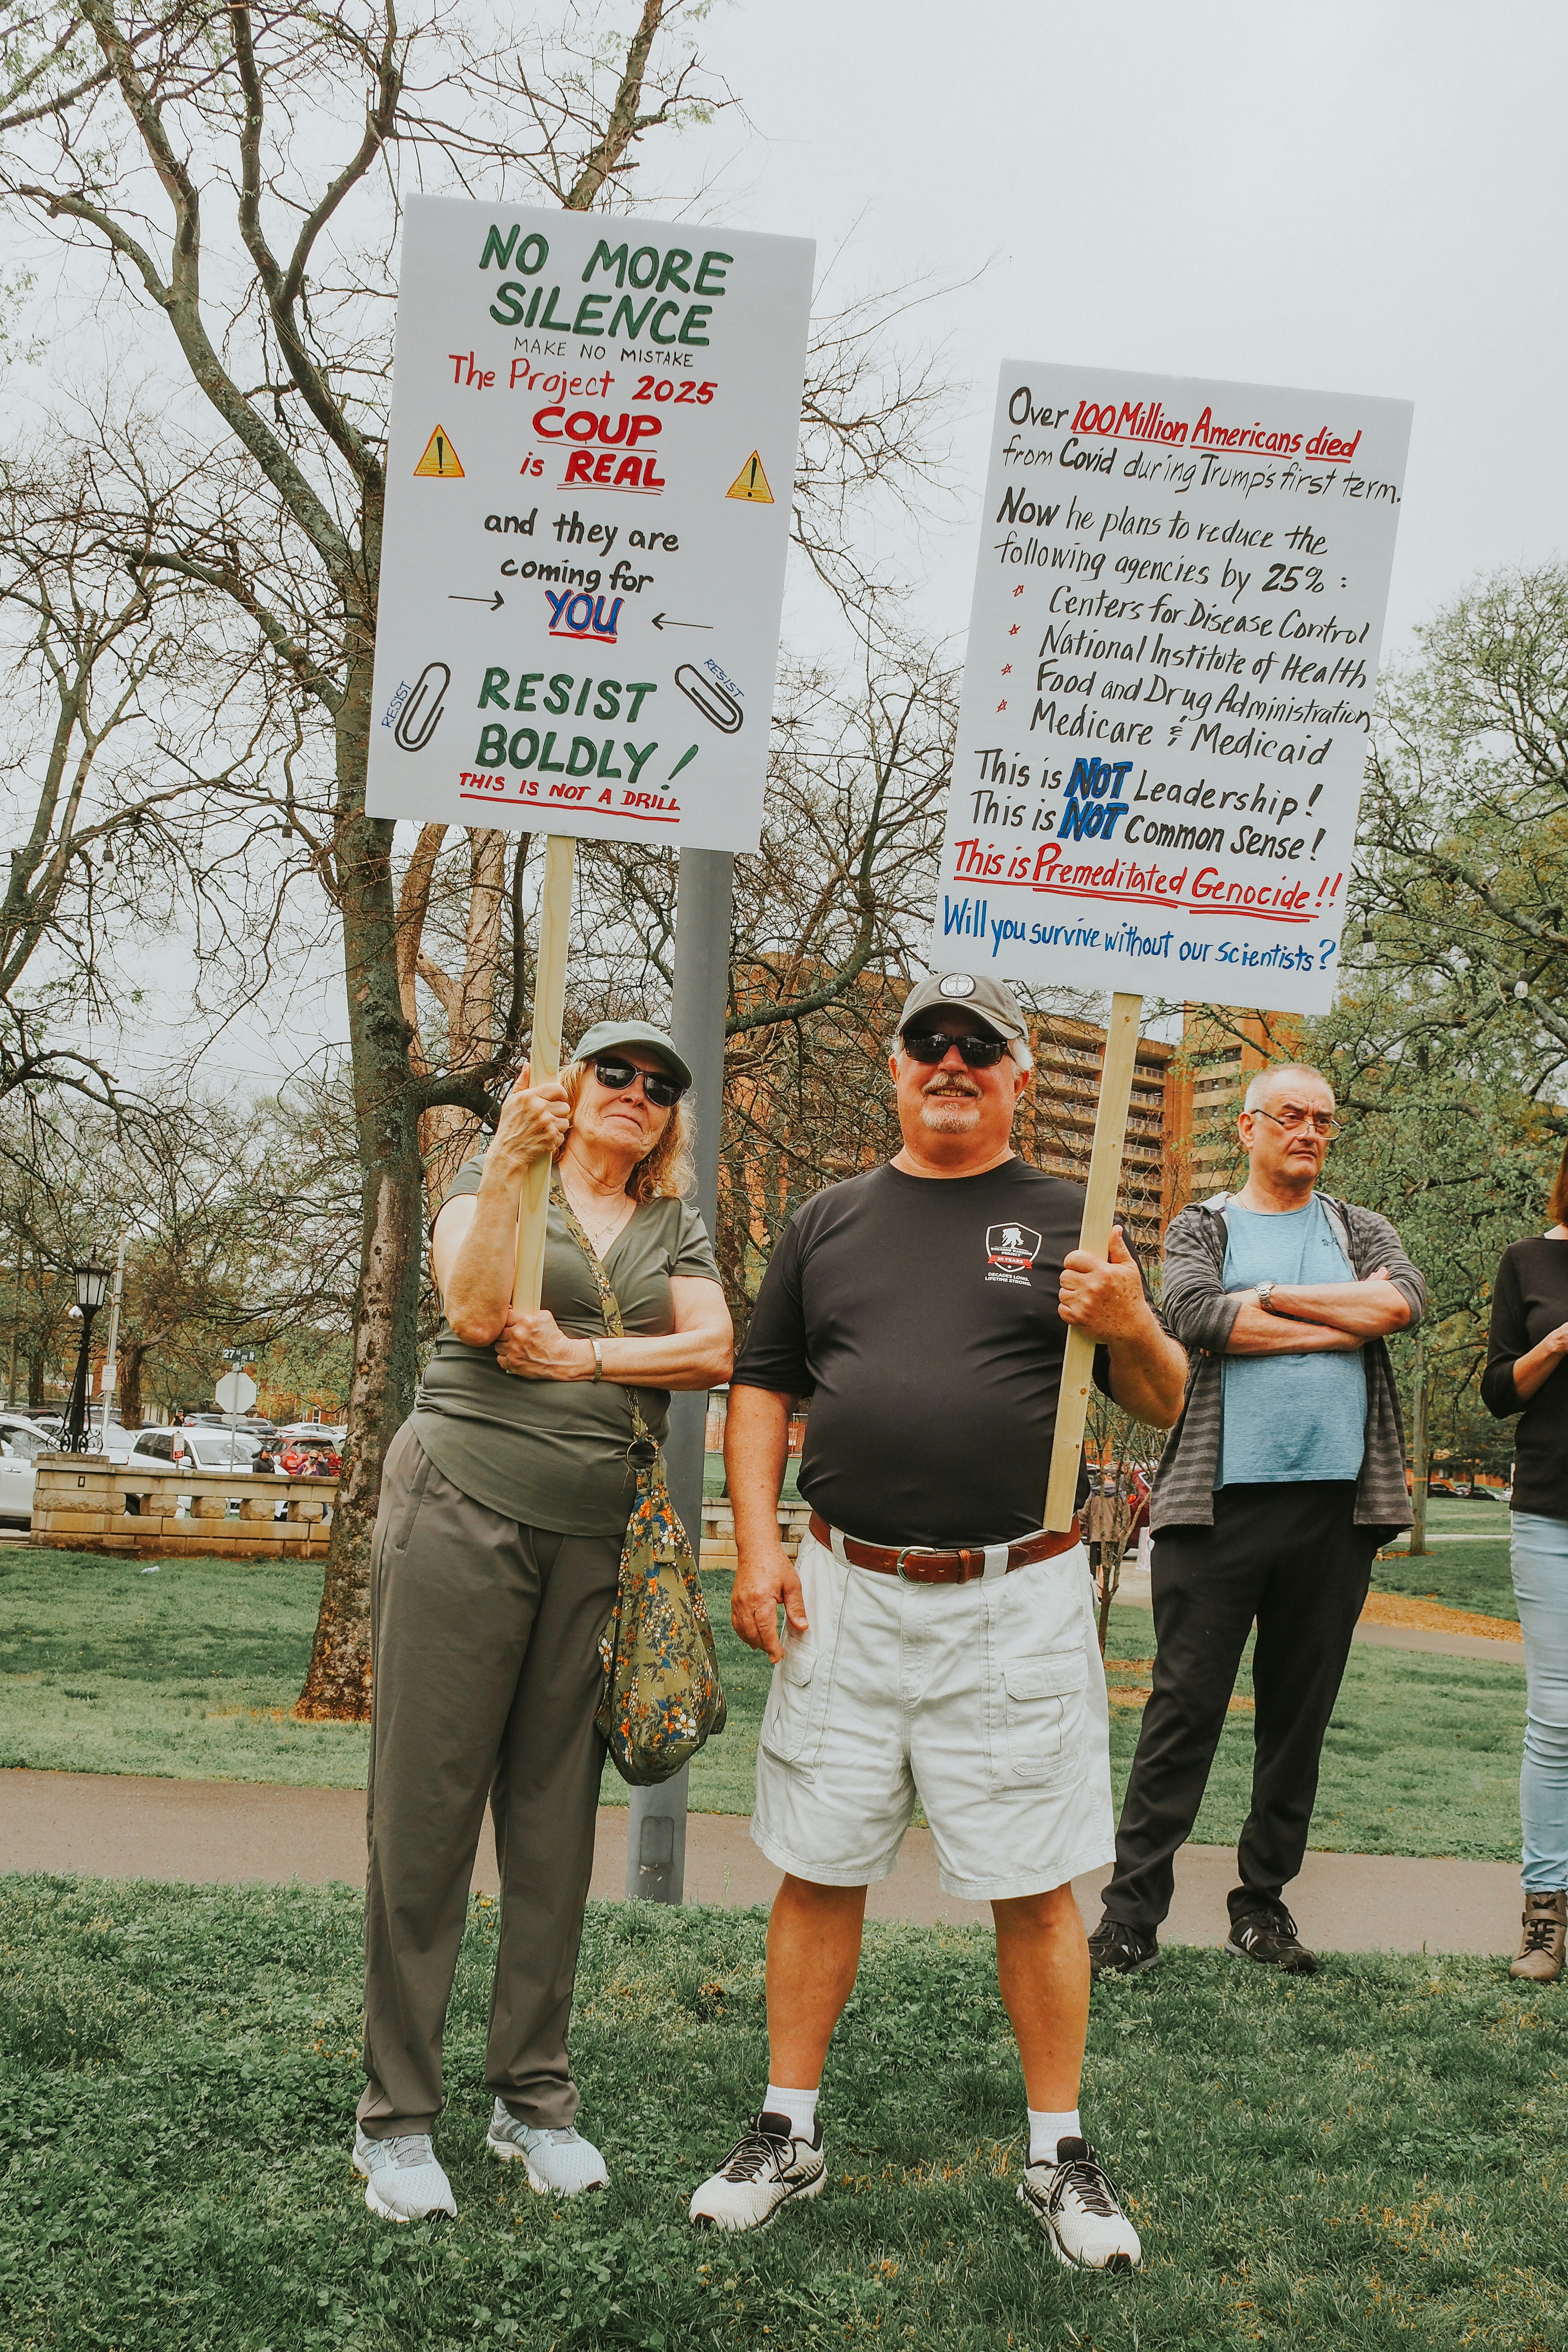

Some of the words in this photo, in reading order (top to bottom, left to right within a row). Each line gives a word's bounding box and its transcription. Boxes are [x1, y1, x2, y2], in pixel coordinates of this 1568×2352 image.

[479, 224, 549, 275] NO
[582, 240, 734, 296] MORE
[490, 282, 713, 346] SILENCE
[449, 351, 495, 391] The
[510, 358, 615, 404] Project
[632, 375, 718, 405] 2025
[514, 337, 566, 356] MAKE
[580, 343, 605, 359] NO
[621, 348, 693, 367] MISTAKE
[533, 407, 662, 446] COUP
[1009, 387, 1069, 429] Over
[1191, 407, 1303, 453] Americans
[1306, 426, 1362, 457] died
[519, 452, 544, 477] is
[564, 451, 666, 487] REAL
[1003, 434, 1052, 466] from
[1059, 437, 1117, 475] Covid
[1124, 450, 1196, 493] during
[1280, 462, 1337, 495] first
[1343, 470, 1402, 504] term.
[485, 508, 538, 536] and
[552, 511, 618, 557] they
[629, 530, 679, 552] are
[996, 486, 1060, 526] Now
[1066, 495, 1095, 530] he
[1099, 506, 1162, 542] plans
[1168, 510, 1189, 539] to
[1197, 519, 1273, 548] reduce
[1285, 525, 1328, 555] the
[500, 559, 602, 593] coming
[609, 560, 654, 593] for
[994, 531, 1106, 581] following
[1115, 555, 1209, 584] agencies
[1221, 558, 1251, 604] by
[545, 589, 625, 635] YOU
[1049, 586, 1144, 619] Centers
[1148, 593, 1187, 623] for
[1183, 599, 1273, 636] Disease
[1279, 609, 1369, 644] Control
[704, 659, 745, 698] RESIST
[1039, 620, 1147, 662] National
[1150, 633, 1246, 674] Institute
[1252, 652, 1279, 684] of
[1281, 653, 1366, 688] Health
[382, 681, 412, 728] RESIST
[477, 667, 657, 723] RESIST
[1037, 659, 1097, 696] Food
[1101, 679, 1140, 701] and
[1143, 675, 1212, 721] Drug
[1215, 683, 1370, 733] Administration
[1030, 698, 1153, 745] Medicare
[1190, 723, 1333, 764] Medicaid
[460, 773, 505, 791] THIS
[519, 780, 539, 796] IS
[549, 783, 592, 800] NOT
[598, 788, 612, 804] A
[622, 791, 681, 811] DRILL
[975, 749, 1029, 787] This
[1040, 758, 1062, 789] is
[1063, 757, 1133, 800] NOT
[970, 790, 1026, 827] This
[1032, 799, 1057, 831] is
[1057, 797, 1129, 841] NOT
[1124, 815, 1225, 853] Common
[955, 838, 1005, 875] This
[1007, 846, 1031, 879] is
[1033, 843, 1188, 894] Premeditated
[945, 896, 987, 937] Will
[991, 920, 1025, 957] you
[1029, 918, 1102, 947] survive
[1105, 922, 1174, 958] without
[1179, 941, 1214, 962] our
